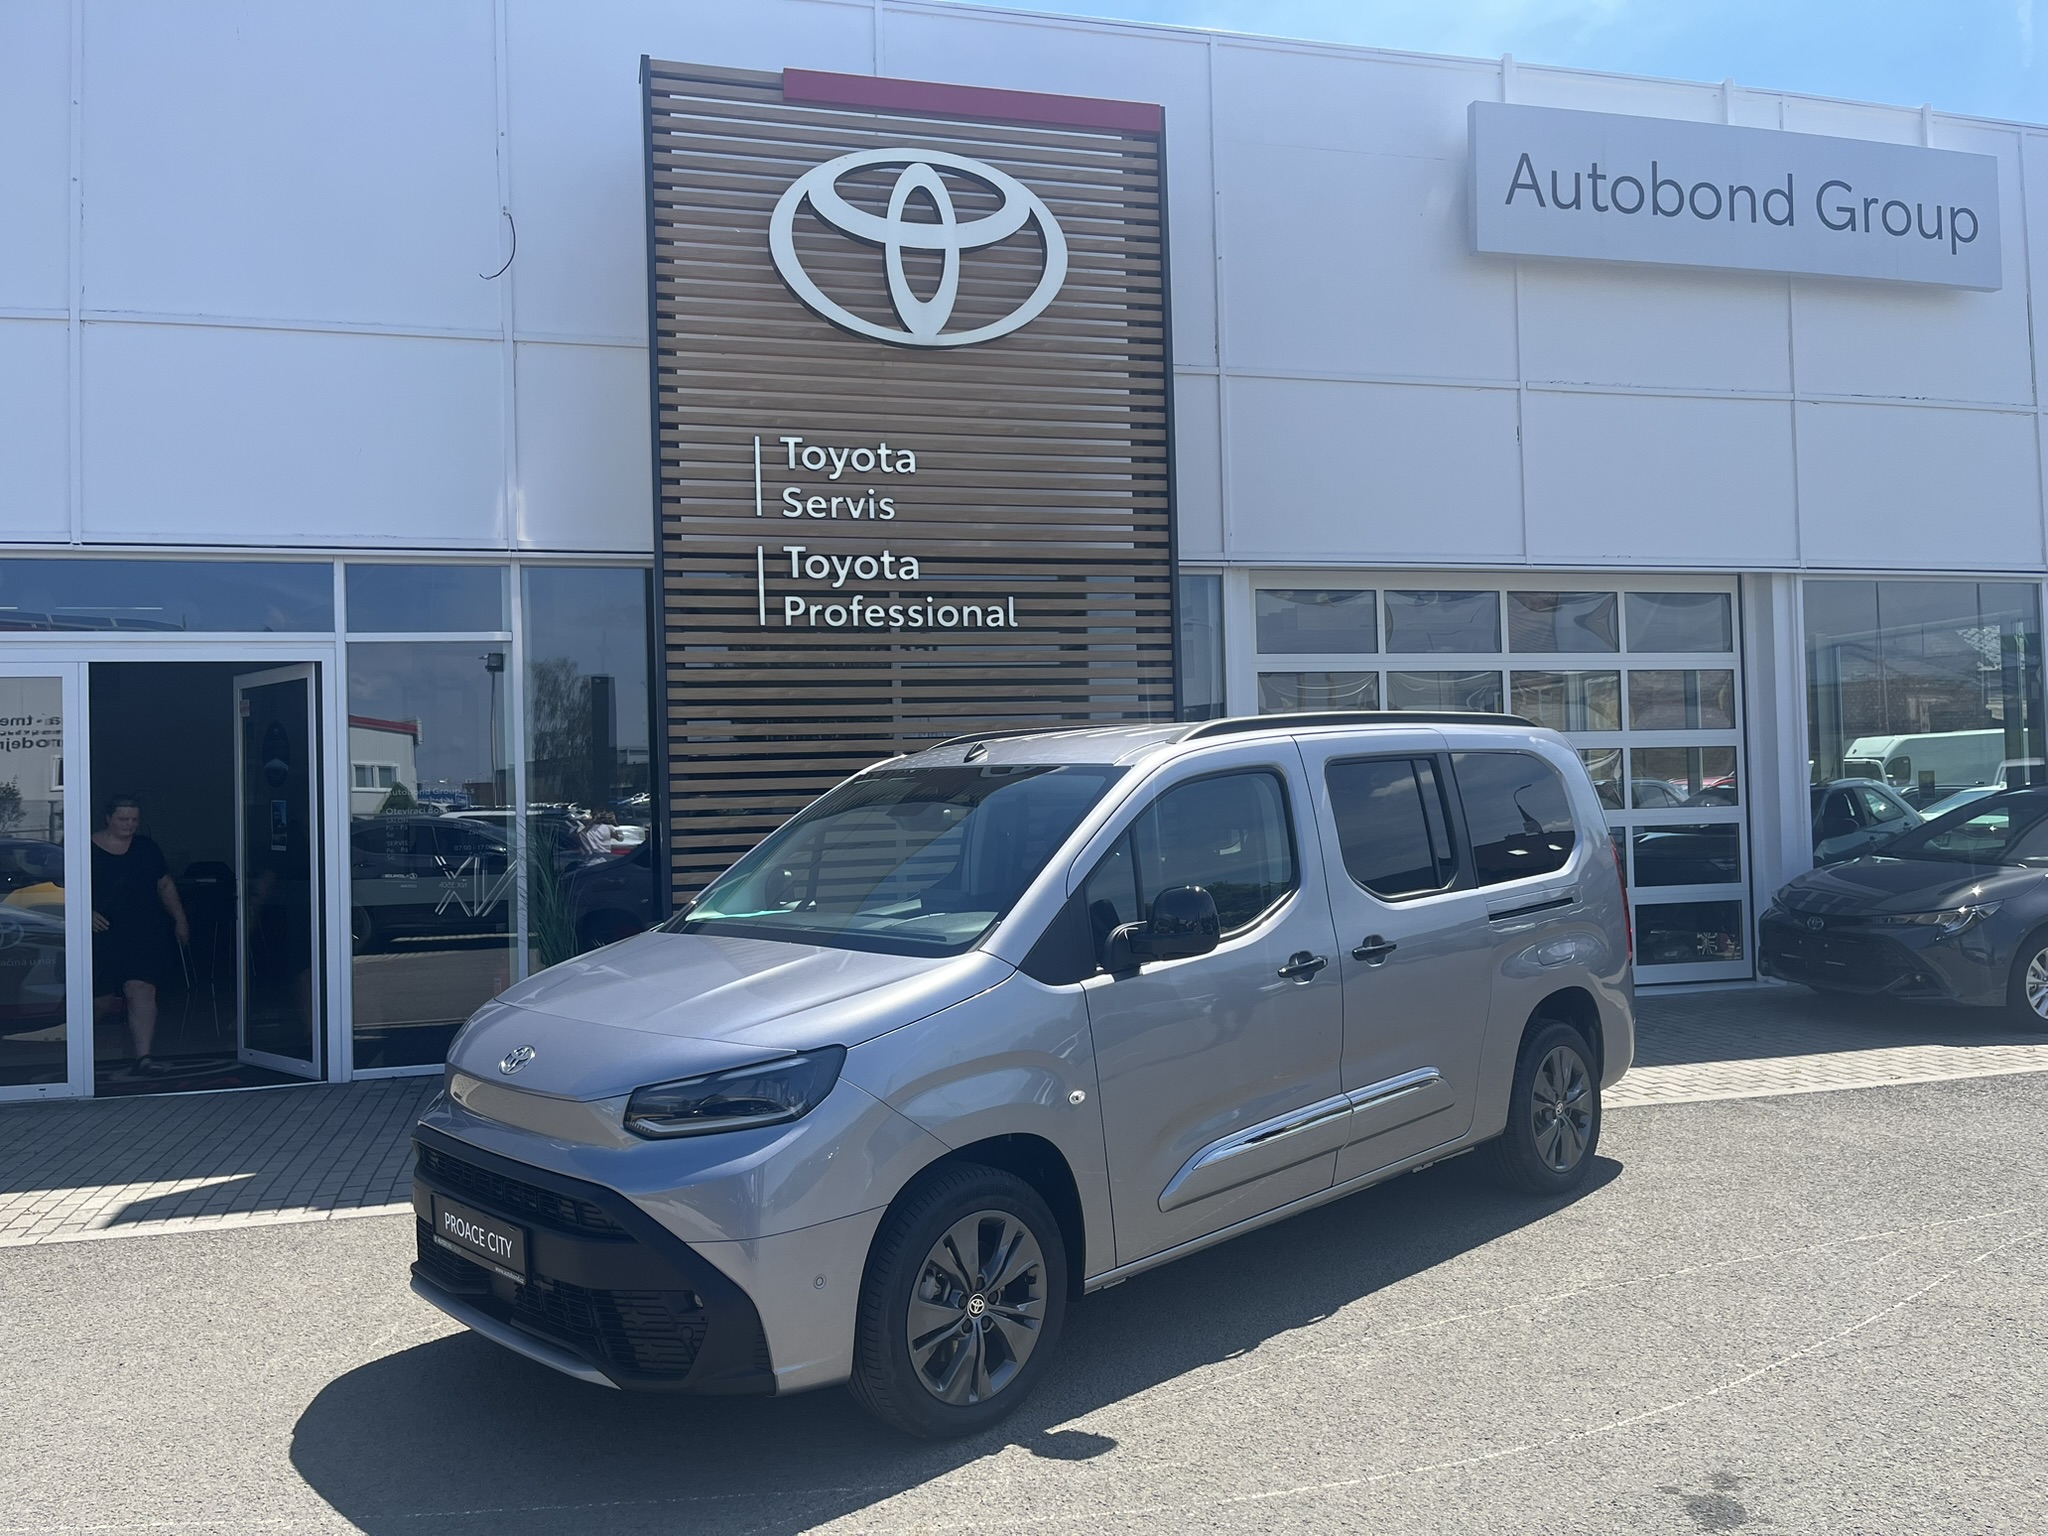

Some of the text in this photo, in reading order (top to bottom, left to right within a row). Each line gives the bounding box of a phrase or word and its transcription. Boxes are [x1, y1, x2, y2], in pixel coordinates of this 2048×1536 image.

[1504, 152, 1980, 256] Autobond Group
[779, 436, 917, 481] Toyota
[782, 487, 896, 520] Servis
[783, 546, 921, 588] Toyota
[784, 596, 1019, 628] Professional
[431, 787, 460, 797] Group
[444, 1212, 513, 1259] PROACE CITY
